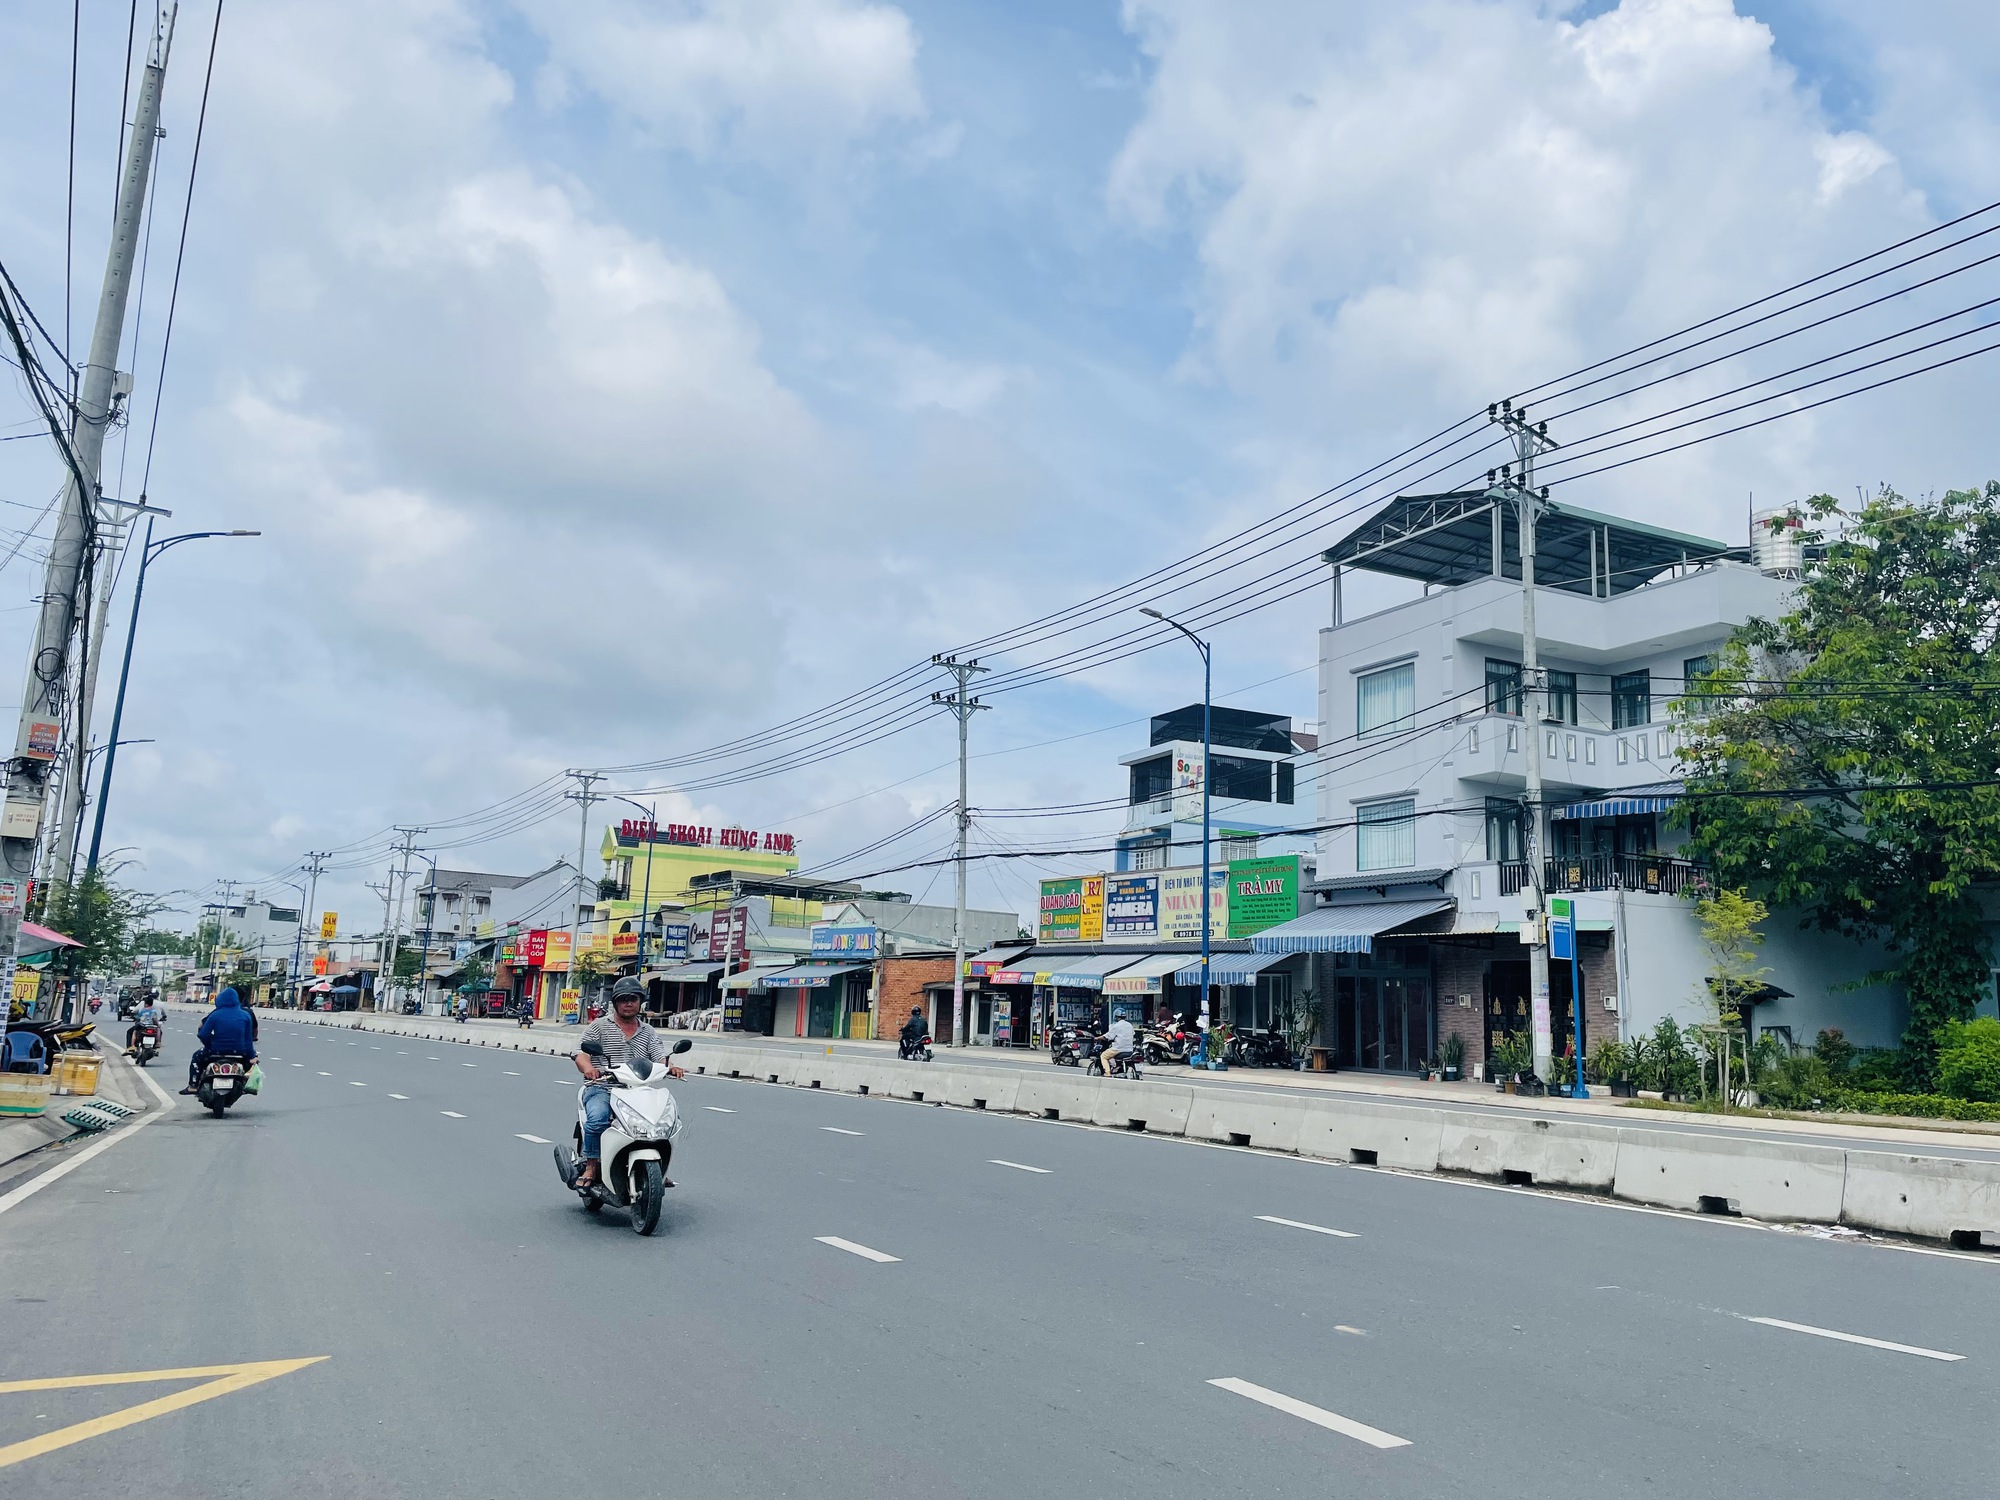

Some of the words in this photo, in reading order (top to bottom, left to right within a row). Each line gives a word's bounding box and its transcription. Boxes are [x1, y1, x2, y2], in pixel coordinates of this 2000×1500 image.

[668, 823, 712, 847] THOẠI
[1236, 874, 1262, 896] TRÀ
[1264, 878, 1284, 894] MY
[1040, 887, 1064, 910] QUẢNG
[1065, 888, 1080, 908] CÁO
[1107, 900, 1155, 918] CAMERA
[1164, 890, 1198, 911] NHÂN
[1199, 892, 1223, 910] LD
[531, 935, 546, 943] BÁN
[11, 983, 36, 999] OPY
